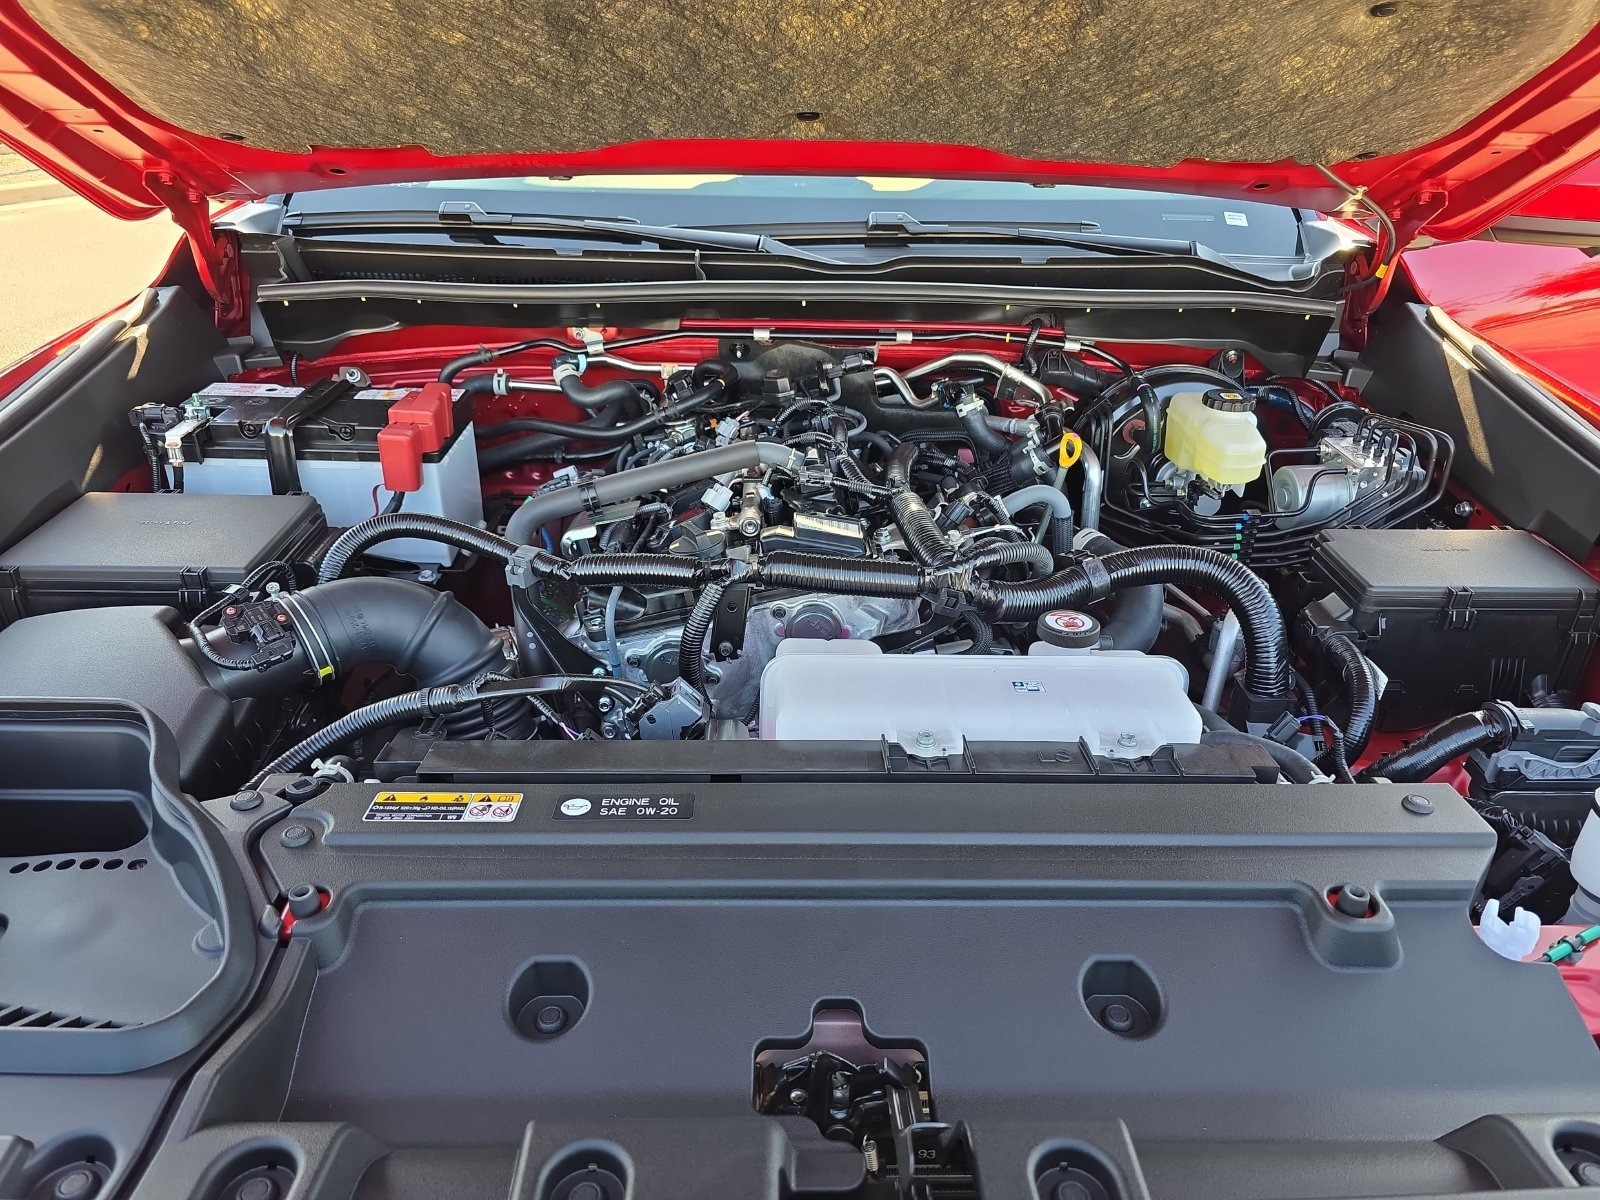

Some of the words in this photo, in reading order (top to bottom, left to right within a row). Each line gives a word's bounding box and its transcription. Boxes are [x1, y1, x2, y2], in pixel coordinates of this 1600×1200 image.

[1036, 750, 1072, 763] LS
[601, 798, 651, 806] ENGINE
[659, 797, 680, 806] OIL
[599, 807, 628, 816] SAE
[636, 807, 678, 816] 0W-20
[918, 1149, 936, 1159] 93
